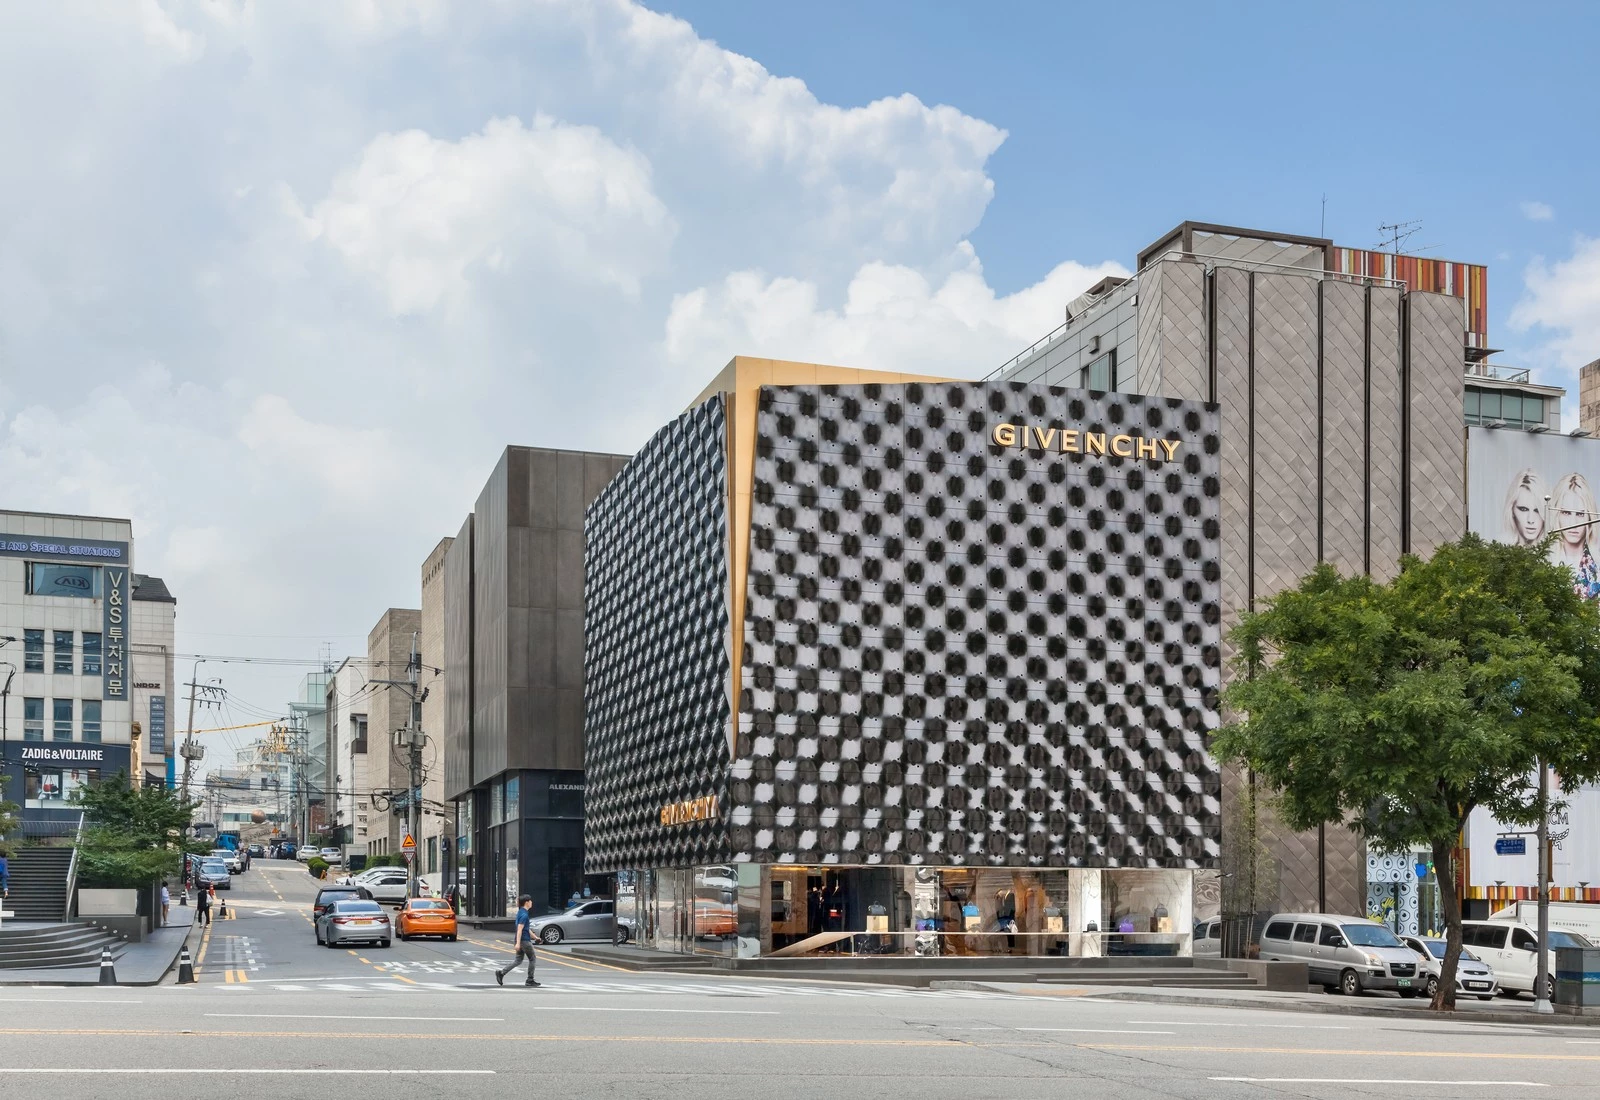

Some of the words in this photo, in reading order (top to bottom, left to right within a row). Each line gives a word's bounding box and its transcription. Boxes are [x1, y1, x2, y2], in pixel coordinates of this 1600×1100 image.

[992, 423, 1181, 461] GIVENCHY
[7, 541, 28, 551] AND
[30, 541, 68, 554] SPECIAL
[69, 546, 121, 557] SITUATIONS
[107, 571, 124, 696] V&S투자자문
